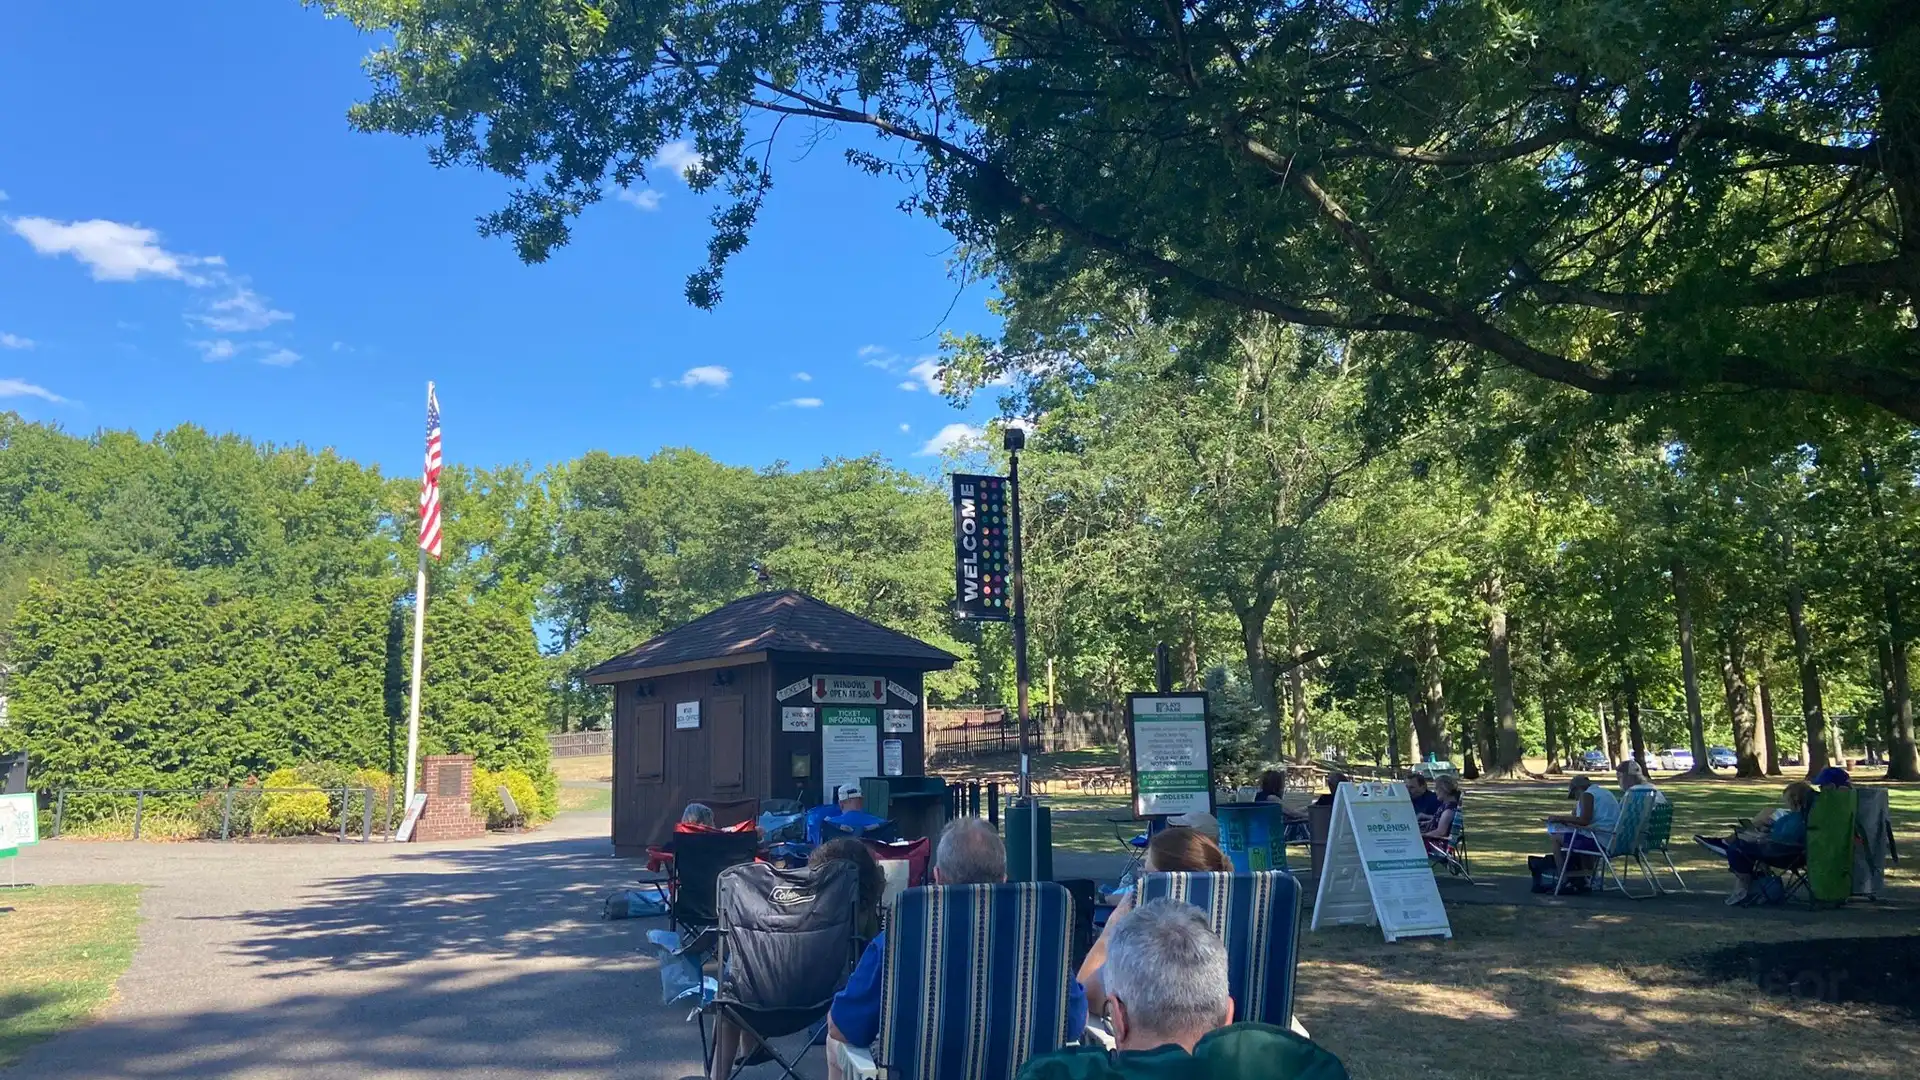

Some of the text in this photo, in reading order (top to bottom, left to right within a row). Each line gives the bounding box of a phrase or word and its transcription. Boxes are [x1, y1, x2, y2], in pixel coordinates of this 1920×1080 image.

[960, 484, 979, 602] WELCOME
[833, 680, 866, 688] WINDOWS
[829, 689, 847, 698] OPEN
[828, 716, 871, 724] INFORMATION
